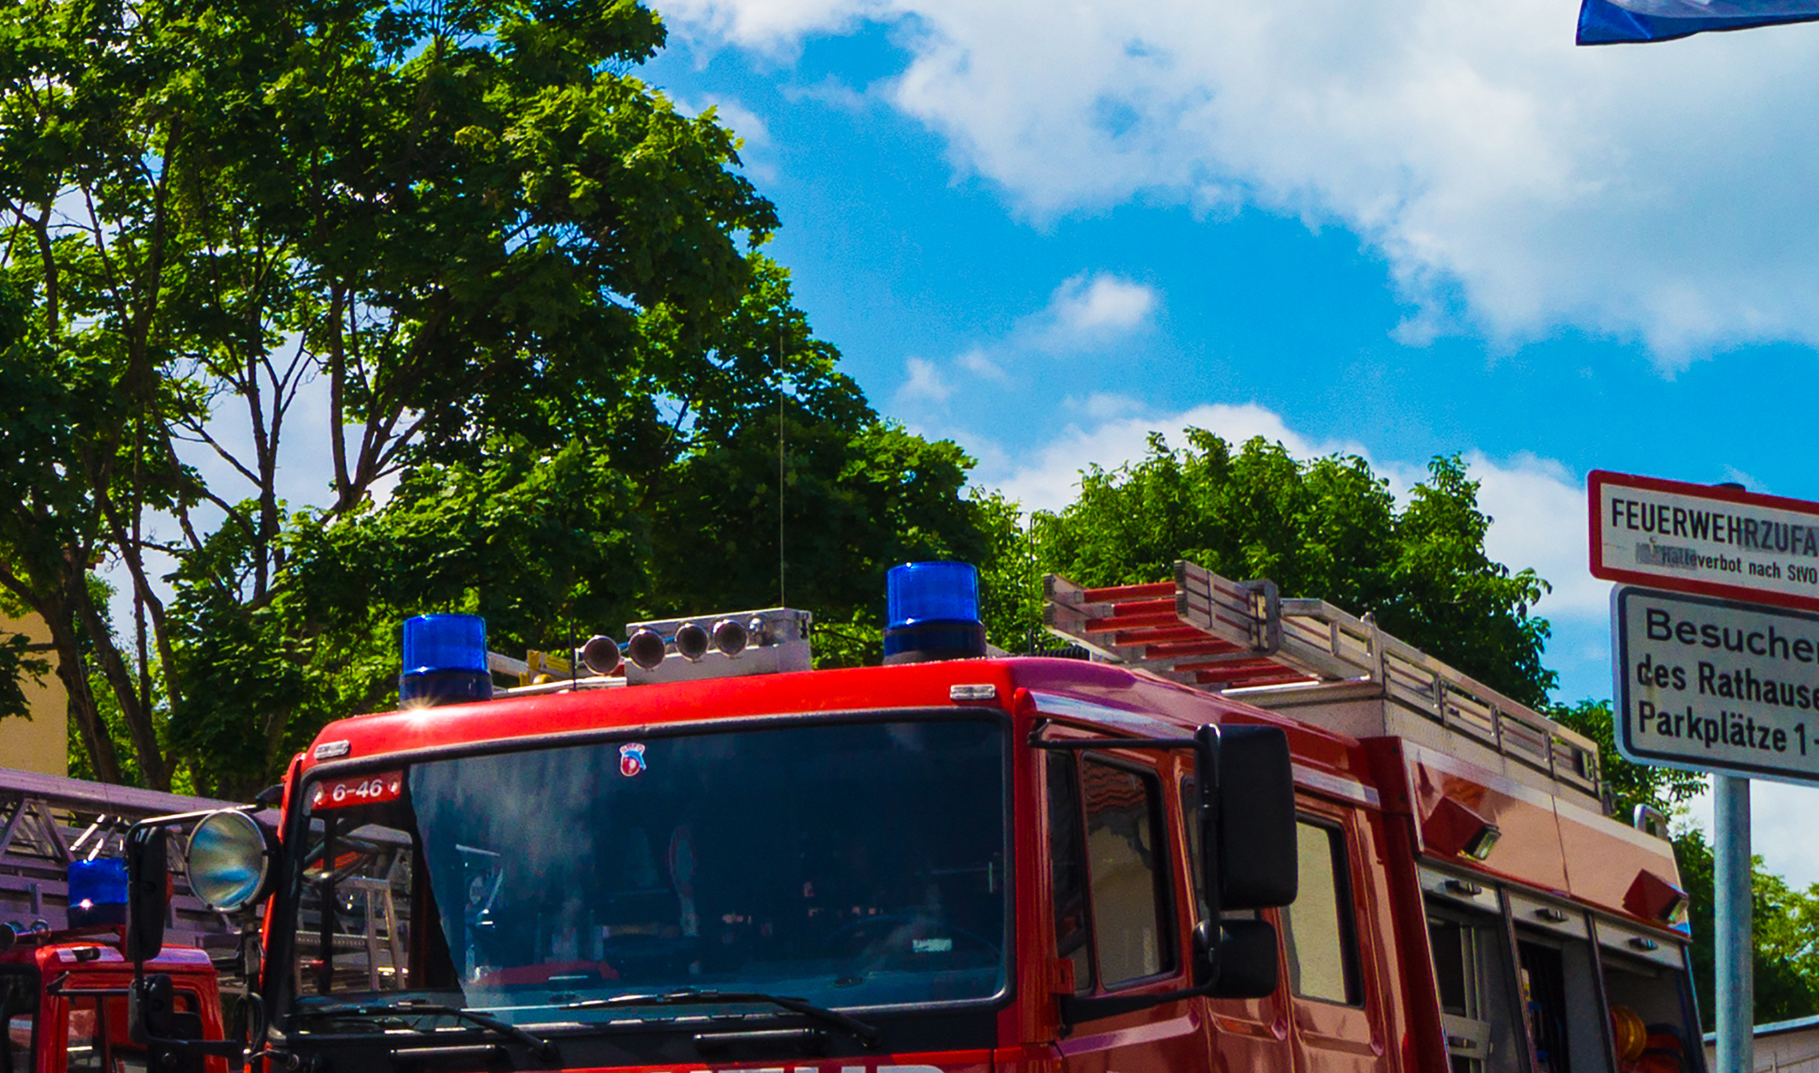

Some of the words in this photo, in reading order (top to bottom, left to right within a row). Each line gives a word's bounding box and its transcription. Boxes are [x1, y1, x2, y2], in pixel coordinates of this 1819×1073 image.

[1748, 561, 1781, 579] nach
[1787, 564, 1818, 585] StVO
[1646, 607, 1819, 664] Besuche
[1637, 653, 1686, 691] des
[1639, 700, 1787, 753] Parkplätze
[1793, 722, 1806, 756] 1
[332, 778, 383, 802] 6-46
